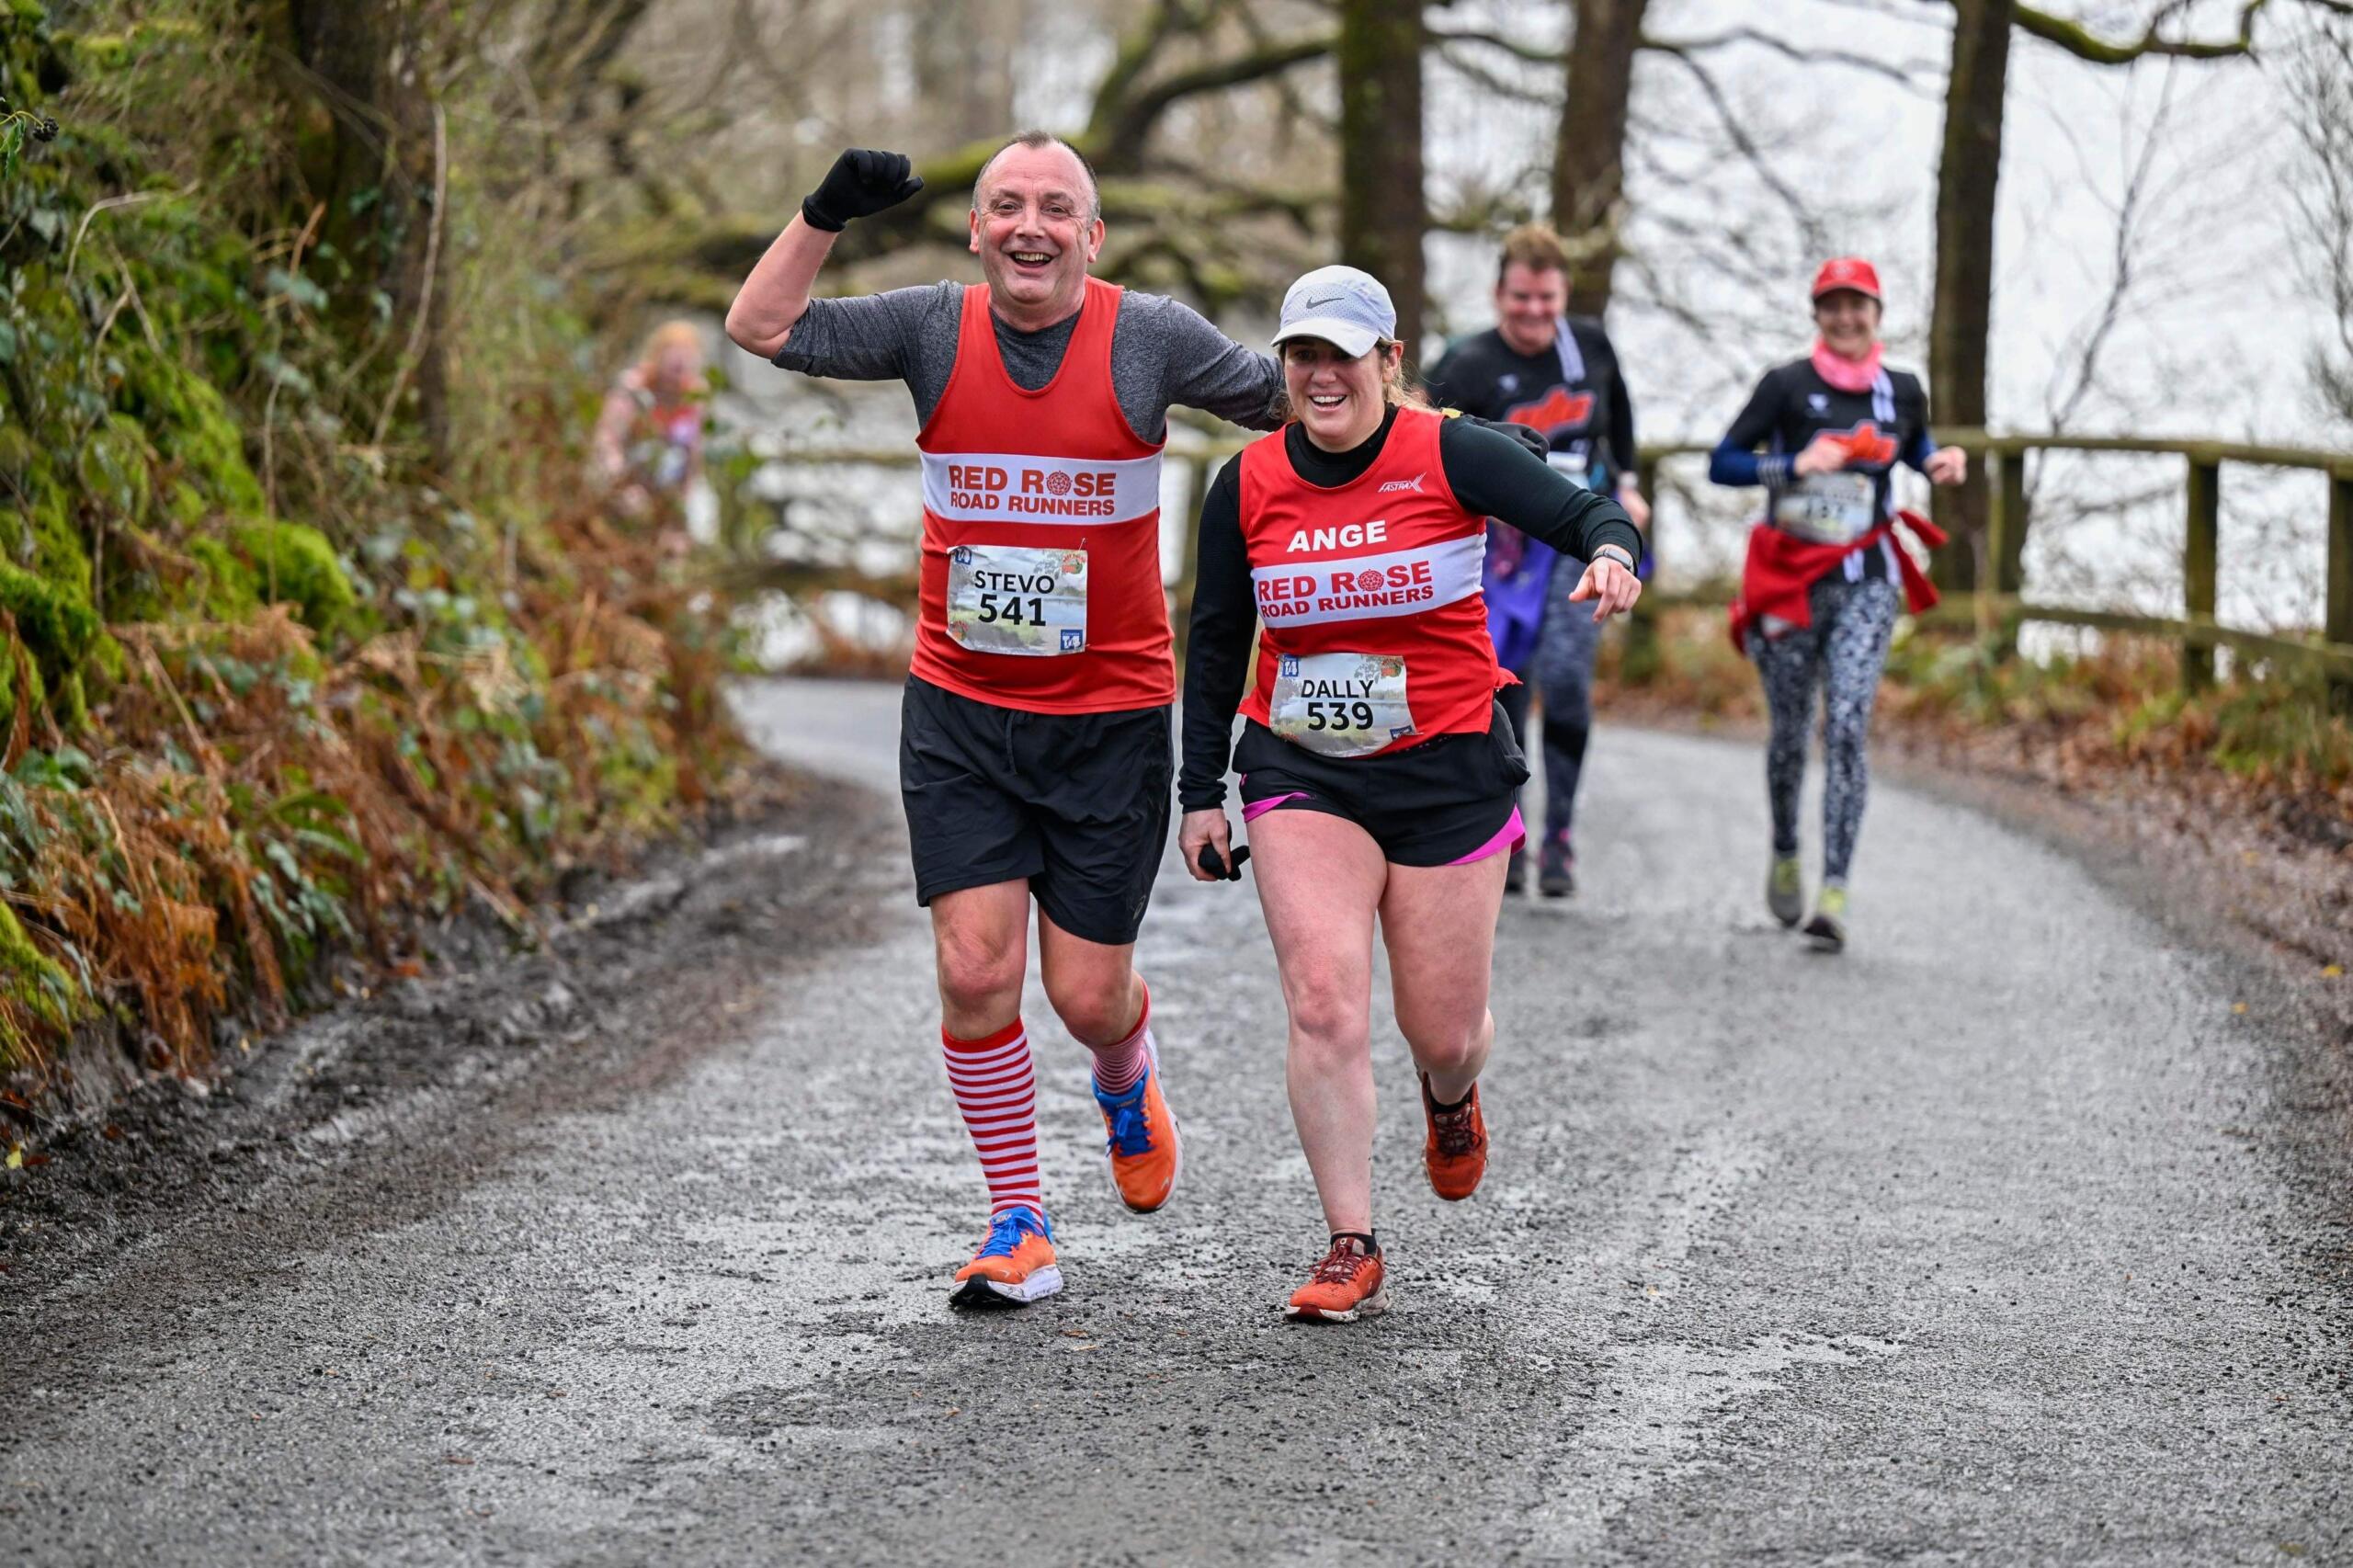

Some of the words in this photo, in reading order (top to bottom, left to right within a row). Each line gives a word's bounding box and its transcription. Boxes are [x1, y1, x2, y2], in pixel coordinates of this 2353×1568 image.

[949, 465, 1008, 491] RED
[1021, 469, 1117, 497] ROSE
[950, 493, 1000, 510] ROAD
[1008, 494, 1115, 517] RUNNERS
[1287, 519, 1387, 552] ANGE
[974, 570, 1055, 595] STEVO
[1258, 575, 1317, 602] RED
[1330, 561, 1432, 595] ROSE
[978, 593, 1047, 627] 541
[1261, 599, 1310, 619] ROAD
[1318, 585, 1434, 612] RUNNERS
[1301, 679, 1374, 699] DALLY
[1307, 701, 1374, 731] 539
